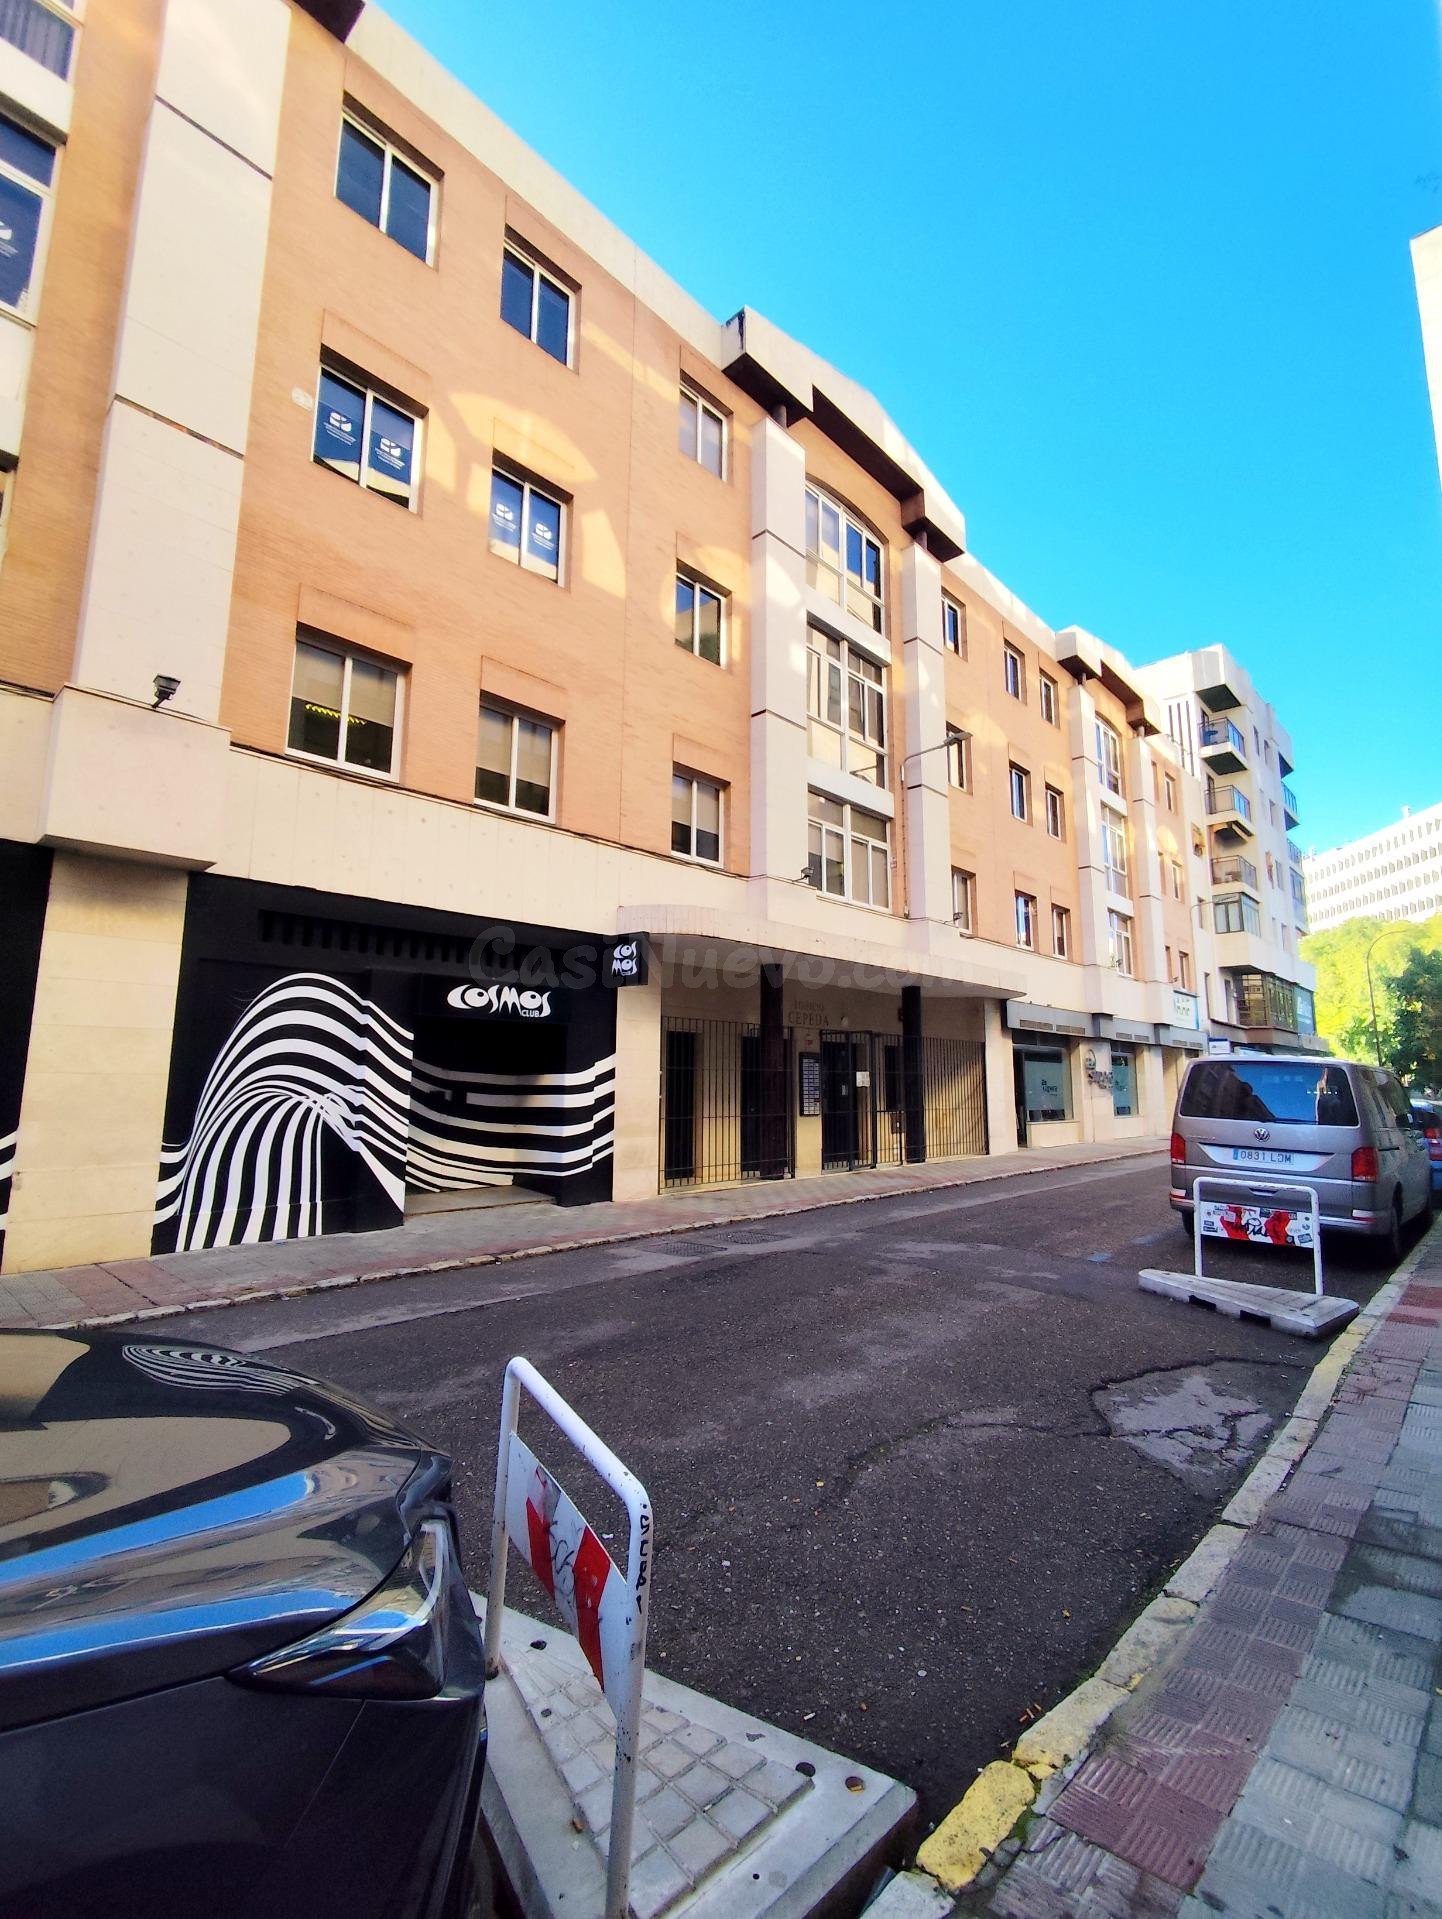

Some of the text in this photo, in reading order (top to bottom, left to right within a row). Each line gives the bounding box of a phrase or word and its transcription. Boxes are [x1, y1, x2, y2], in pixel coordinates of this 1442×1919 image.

[447, 984, 551, 1018] COSMOS
[521, 1009, 540, 1018] CLUB
[788, 1011, 829, 1026] CEPEDA
[1240, 1150, 1266, 1161] 0831
